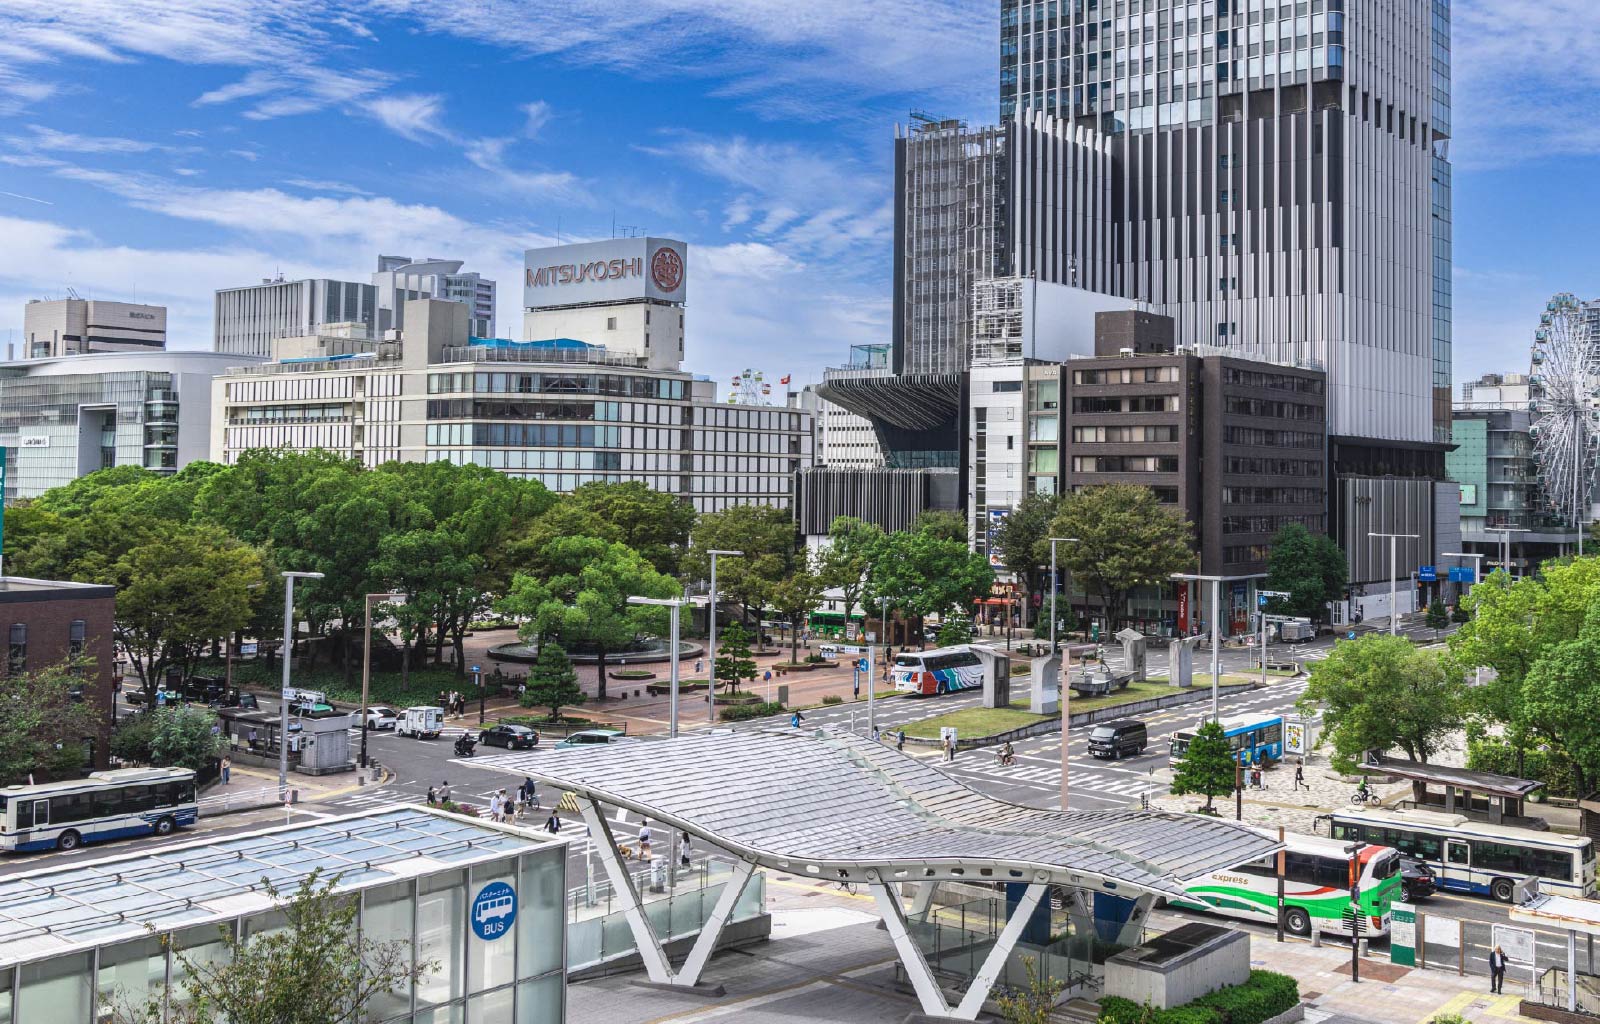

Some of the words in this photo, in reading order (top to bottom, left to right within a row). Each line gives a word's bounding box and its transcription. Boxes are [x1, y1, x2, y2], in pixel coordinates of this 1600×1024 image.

[526, 256, 641, 288] MITSUKOSHI
[1211, 874, 1249, 885] express
[479, 888, 510, 900] バスターミナル
[484, 921, 504, 935] BUS
